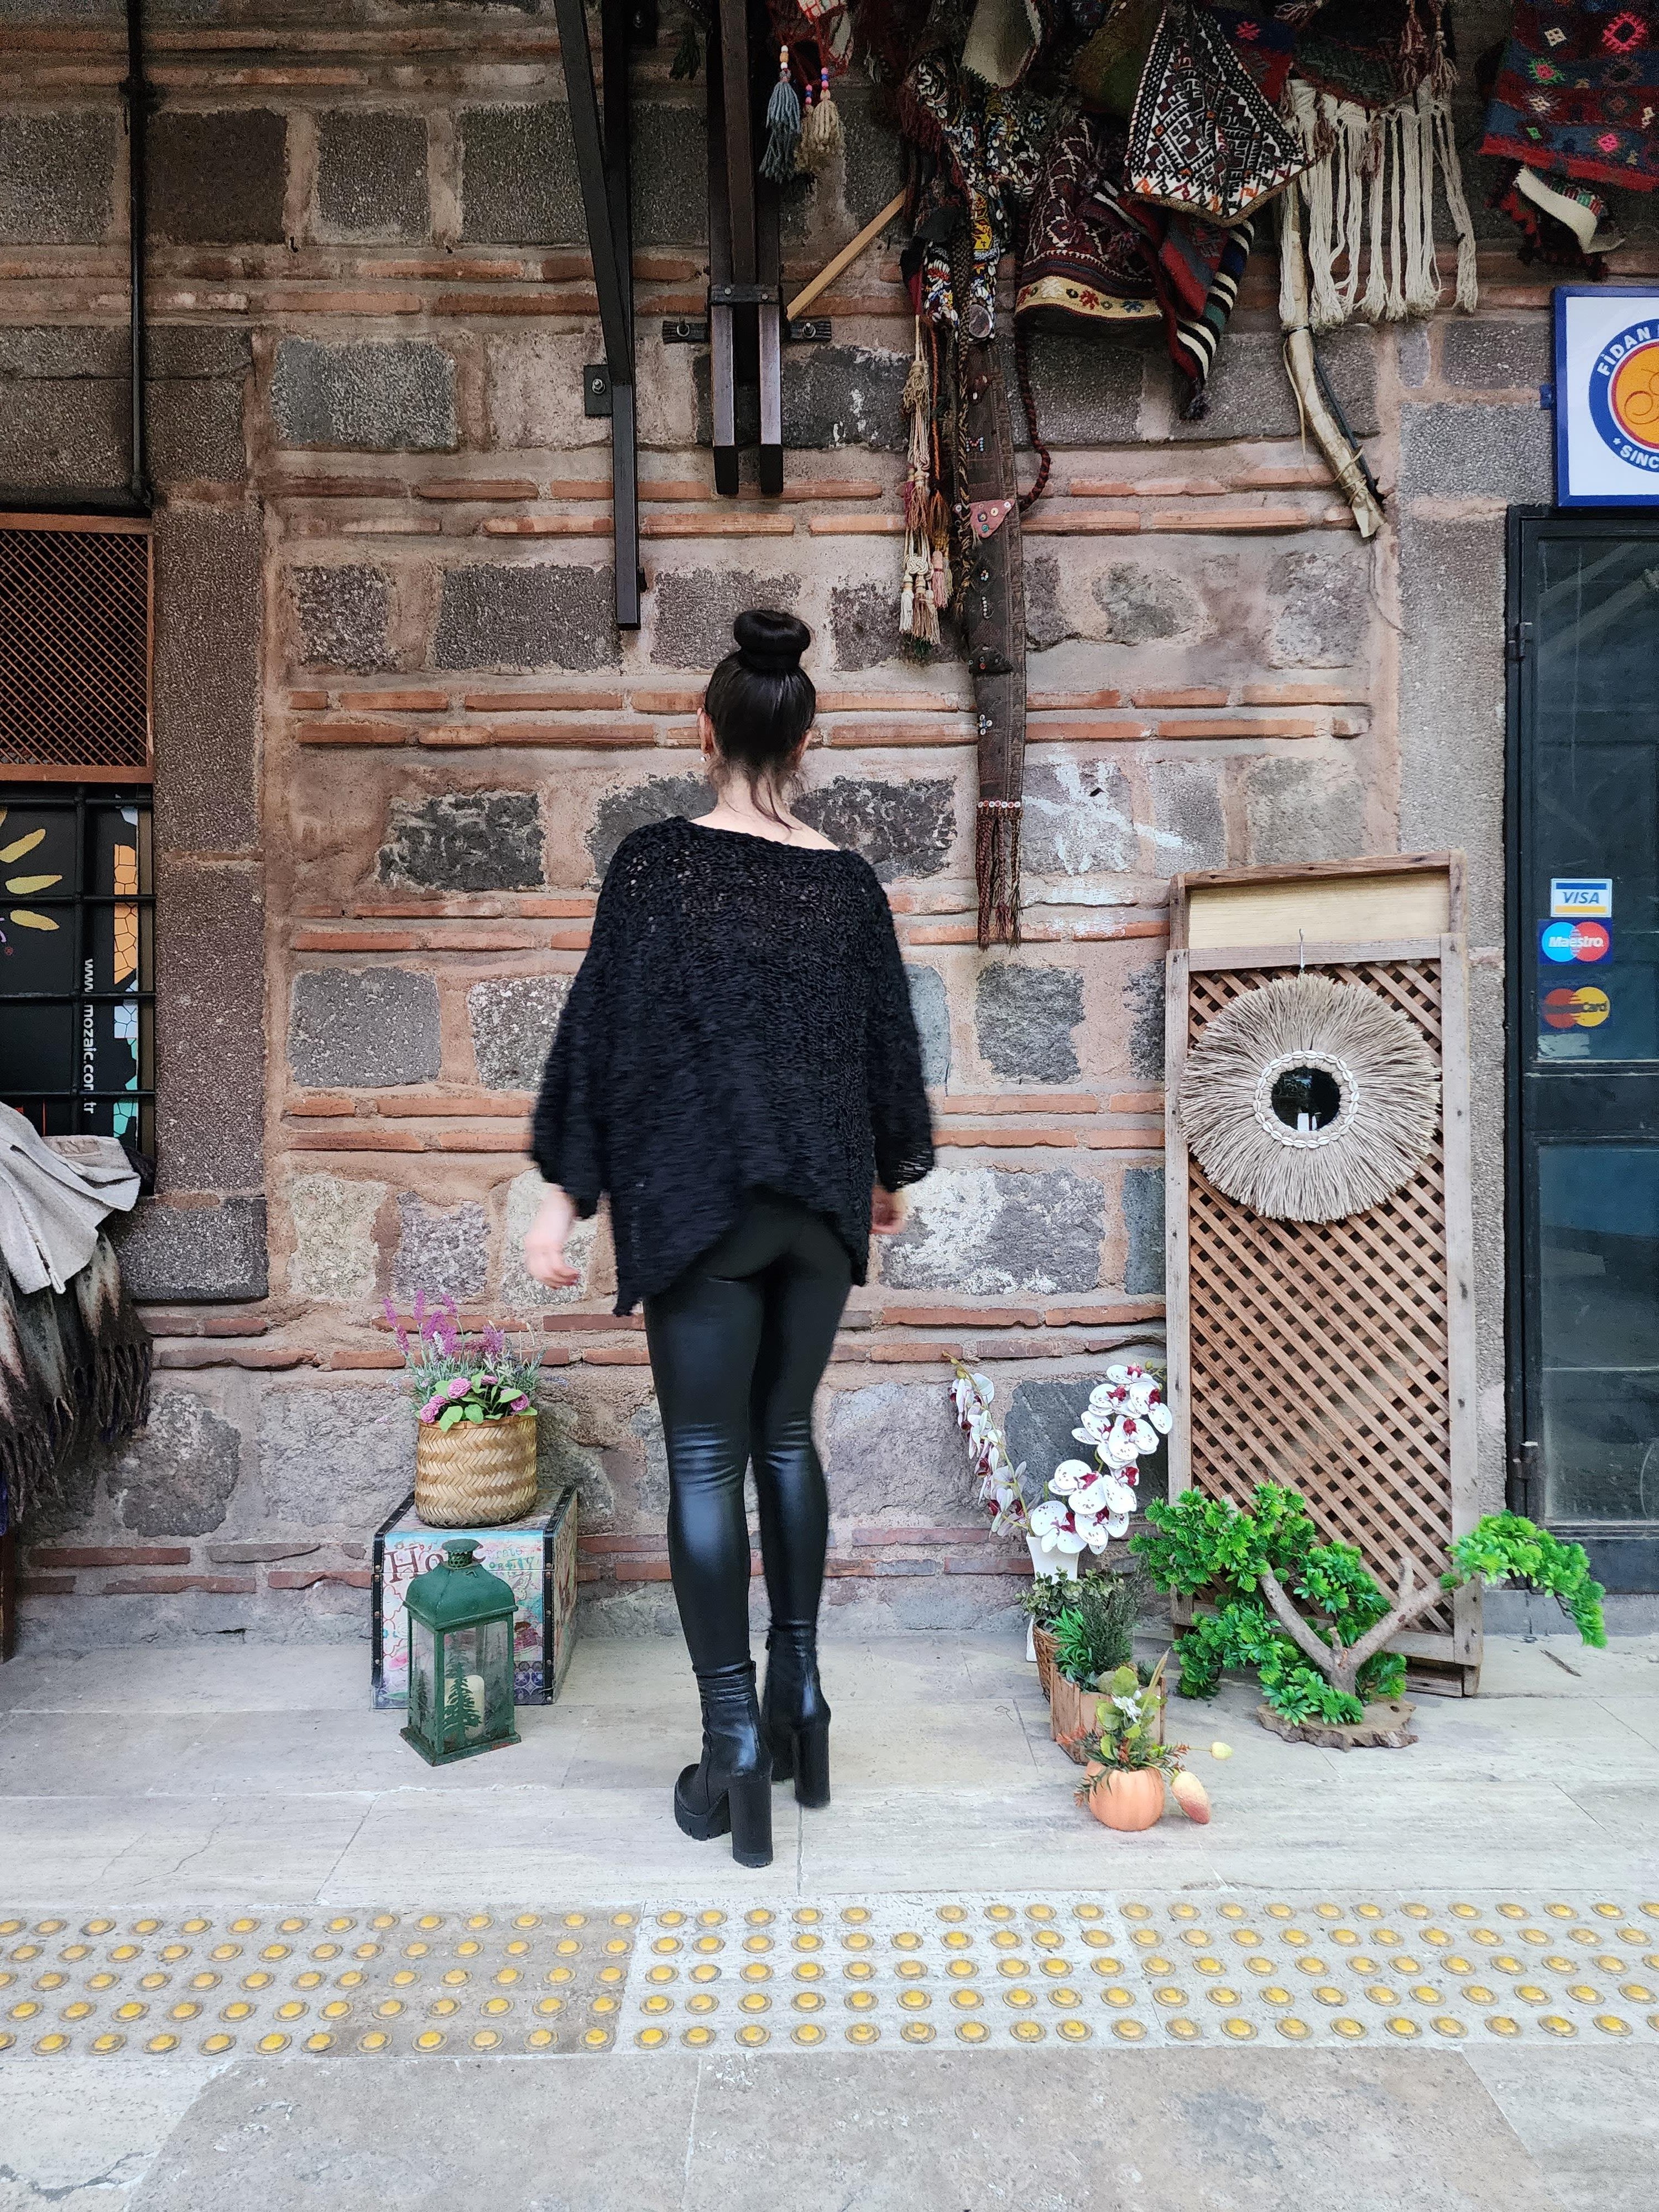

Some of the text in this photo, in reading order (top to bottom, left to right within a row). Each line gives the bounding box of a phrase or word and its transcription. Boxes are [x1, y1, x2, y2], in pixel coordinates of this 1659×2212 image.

[1597, 326, 1651, 376] FİDAN
[1562, 891, 1600, 904] VISA
[1548, 936, 1604, 947] Maestro
